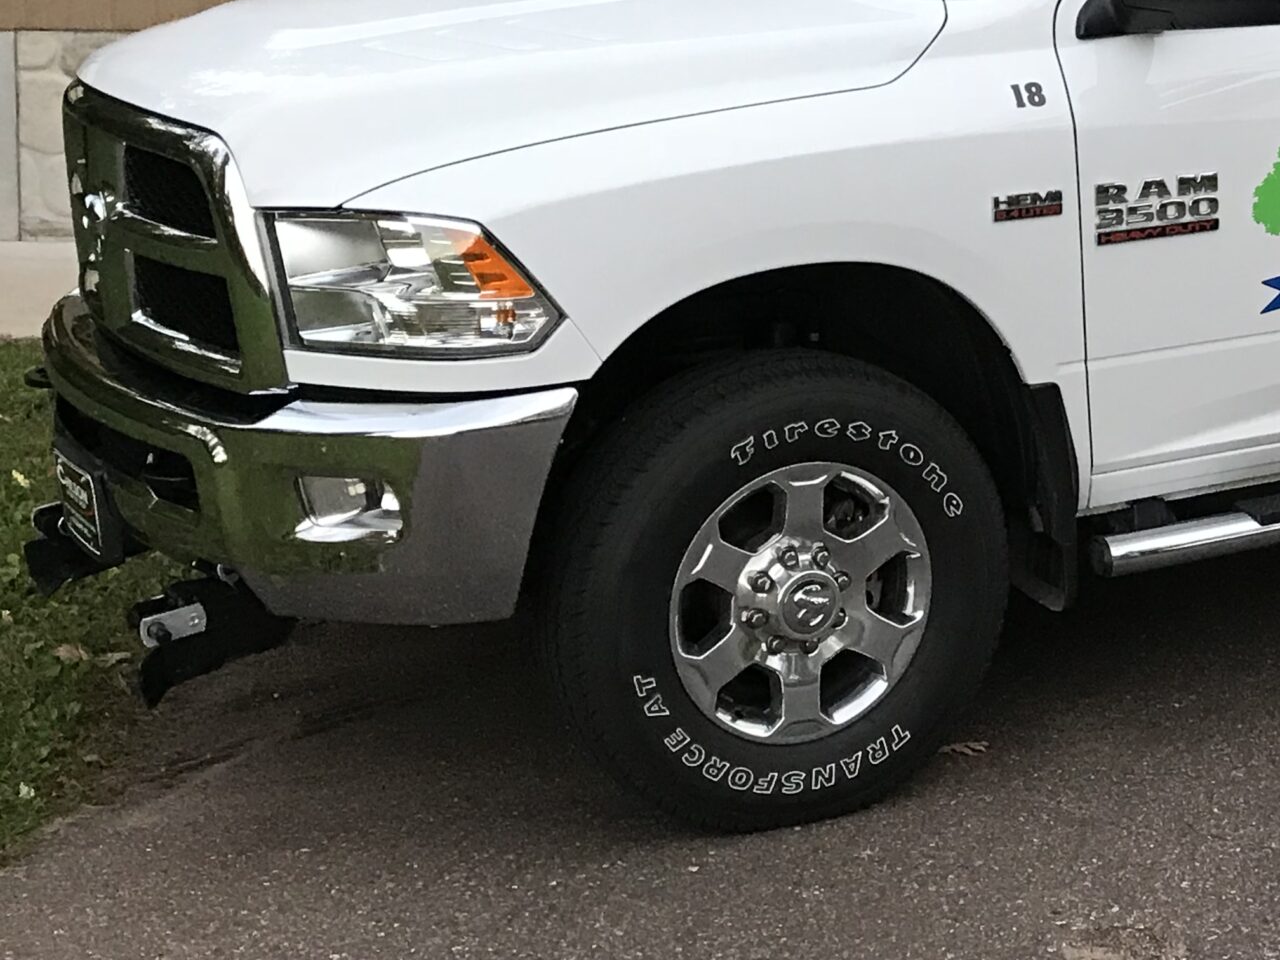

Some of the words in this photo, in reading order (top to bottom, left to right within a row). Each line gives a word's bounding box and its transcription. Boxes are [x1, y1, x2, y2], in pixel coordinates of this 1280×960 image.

[1010, 82, 1047, 108] 18
[993, 190, 1062, 209] HEMI
[1094, 171, 1218, 206] RAM
[1095, 195, 1219, 232] 3500
[1100, 227, 1160, 243] HEAVY
[1165, 221, 1215, 237] DUTY
[730, 418, 964, 518] Firestone
[633, 673, 670, 717] AT
[664, 723, 911, 794] TRANSFORCE
